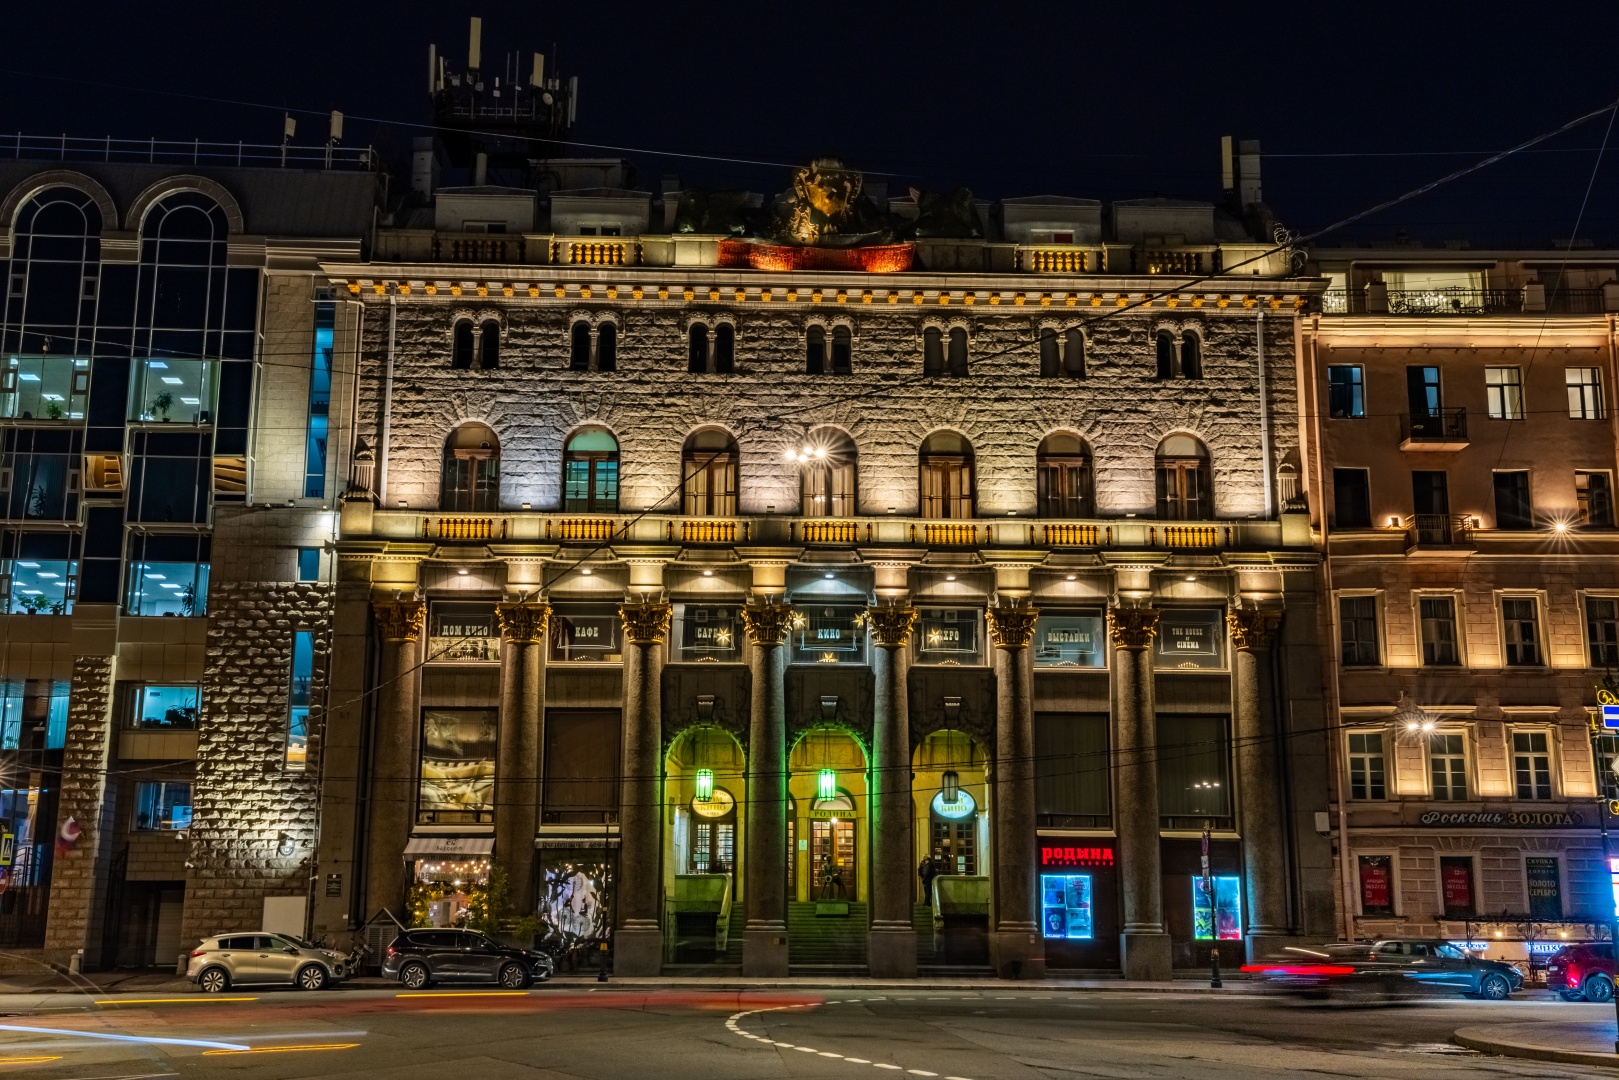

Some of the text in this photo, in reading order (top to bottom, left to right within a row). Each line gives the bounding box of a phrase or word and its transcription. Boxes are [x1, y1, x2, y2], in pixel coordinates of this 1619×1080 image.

[442, 624, 488, 636] ДОМ КИНО
[575, 626, 599, 638] КАФЕ
[817, 628, 841, 639] КИНО
[1172, 627, 1203, 636] THE HOUSE
[1048, 632, 1090, 643] ВЫСТАВКИ
[1176, 641, 1199, 649] CINEMA
[1421, 811, 1574, 825] Роскошь ЗОЛОТА
[1528, 879, 1556, 888] ЗОЛОТО
[1529, 888, 1557, 897] СЕРЕБРО
